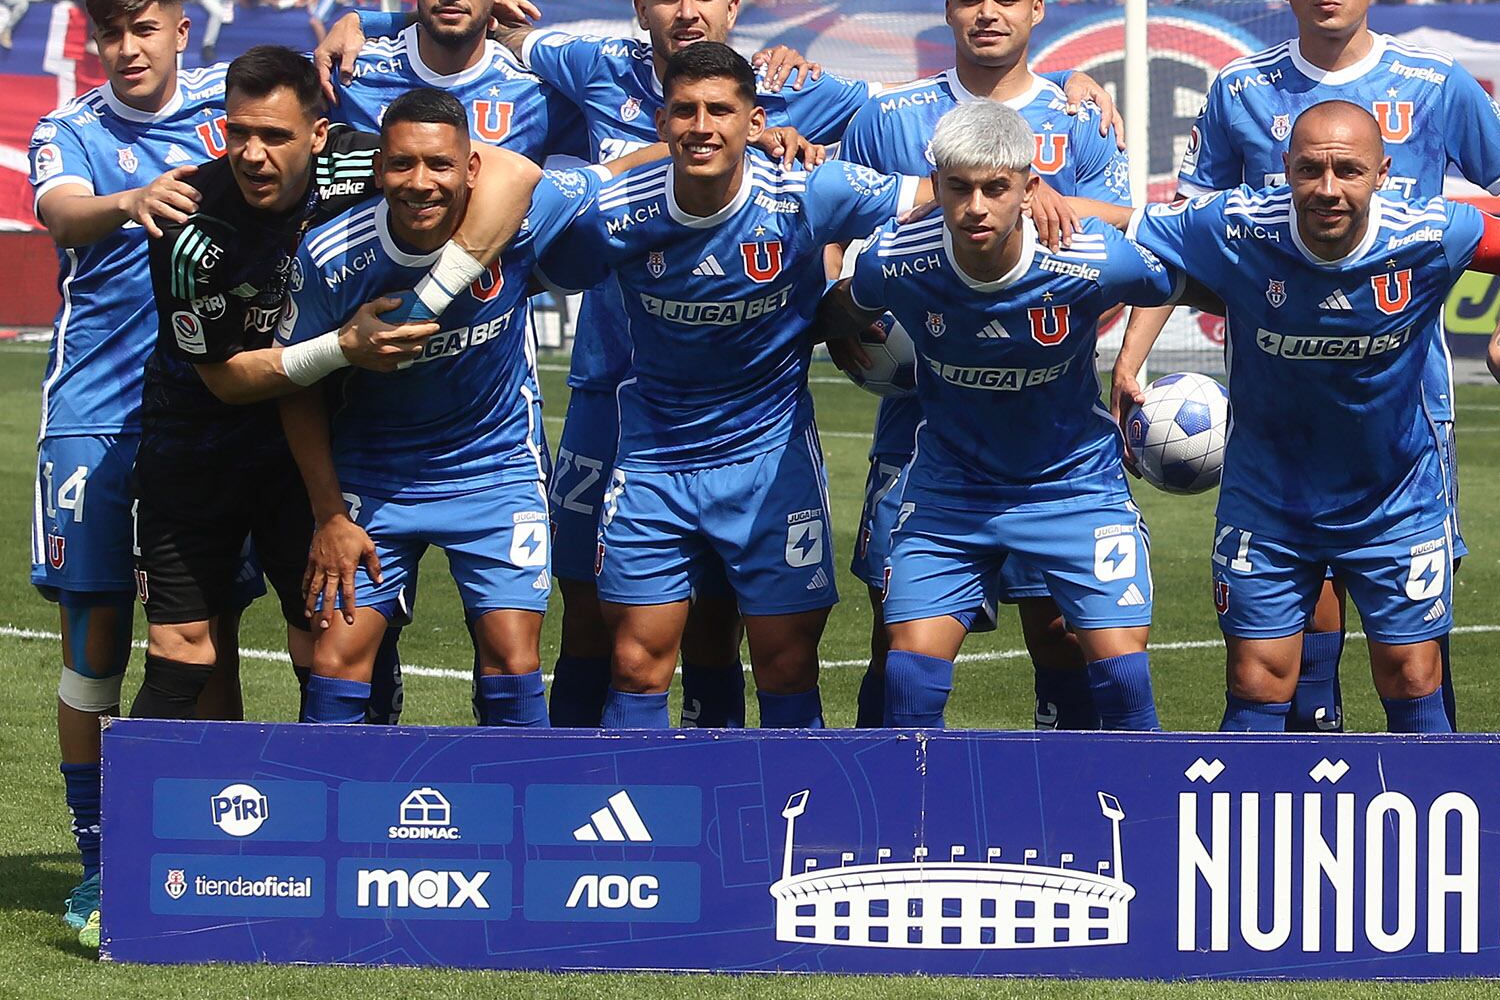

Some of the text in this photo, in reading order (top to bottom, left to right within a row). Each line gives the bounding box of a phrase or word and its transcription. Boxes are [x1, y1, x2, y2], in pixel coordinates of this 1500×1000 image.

[1228, 68, 1284, 96] MACH
[1388, 59, 1446, 84] Impeke
[880, 90, 938, 114] MACH
[472, 99, 514, 142] U
[1373, 102, 1413, 143] U
[1033, 133, 1070, 176] U
[605, 202, 662, 237] MACH
[1225, 223, 1280, 244] MACH
[325, 248, 377, 288] MACH
[740, 241, 783, 283] U
[882, 254, 941, 279] MACH
[664, 284, 793, 324] JUGABET
[1370, 268, 1413, 316] U
[1027, 303, 1070, 347] U
[1281, 325, 1412, 360] JUGABET
[946, 359, 1072, 392] JUGABET
[42, 460, 88, 523] 14
[48, 535, 67, 570] U
[388, 826, 459, 840] SODIMAC
[1177, 756, 1480, 954] ÑUÑOA
[194, 875, 312, 898] tiendaoficial
[357, 868, 491, 909] max
[565, 874, 660, 910] AOC
